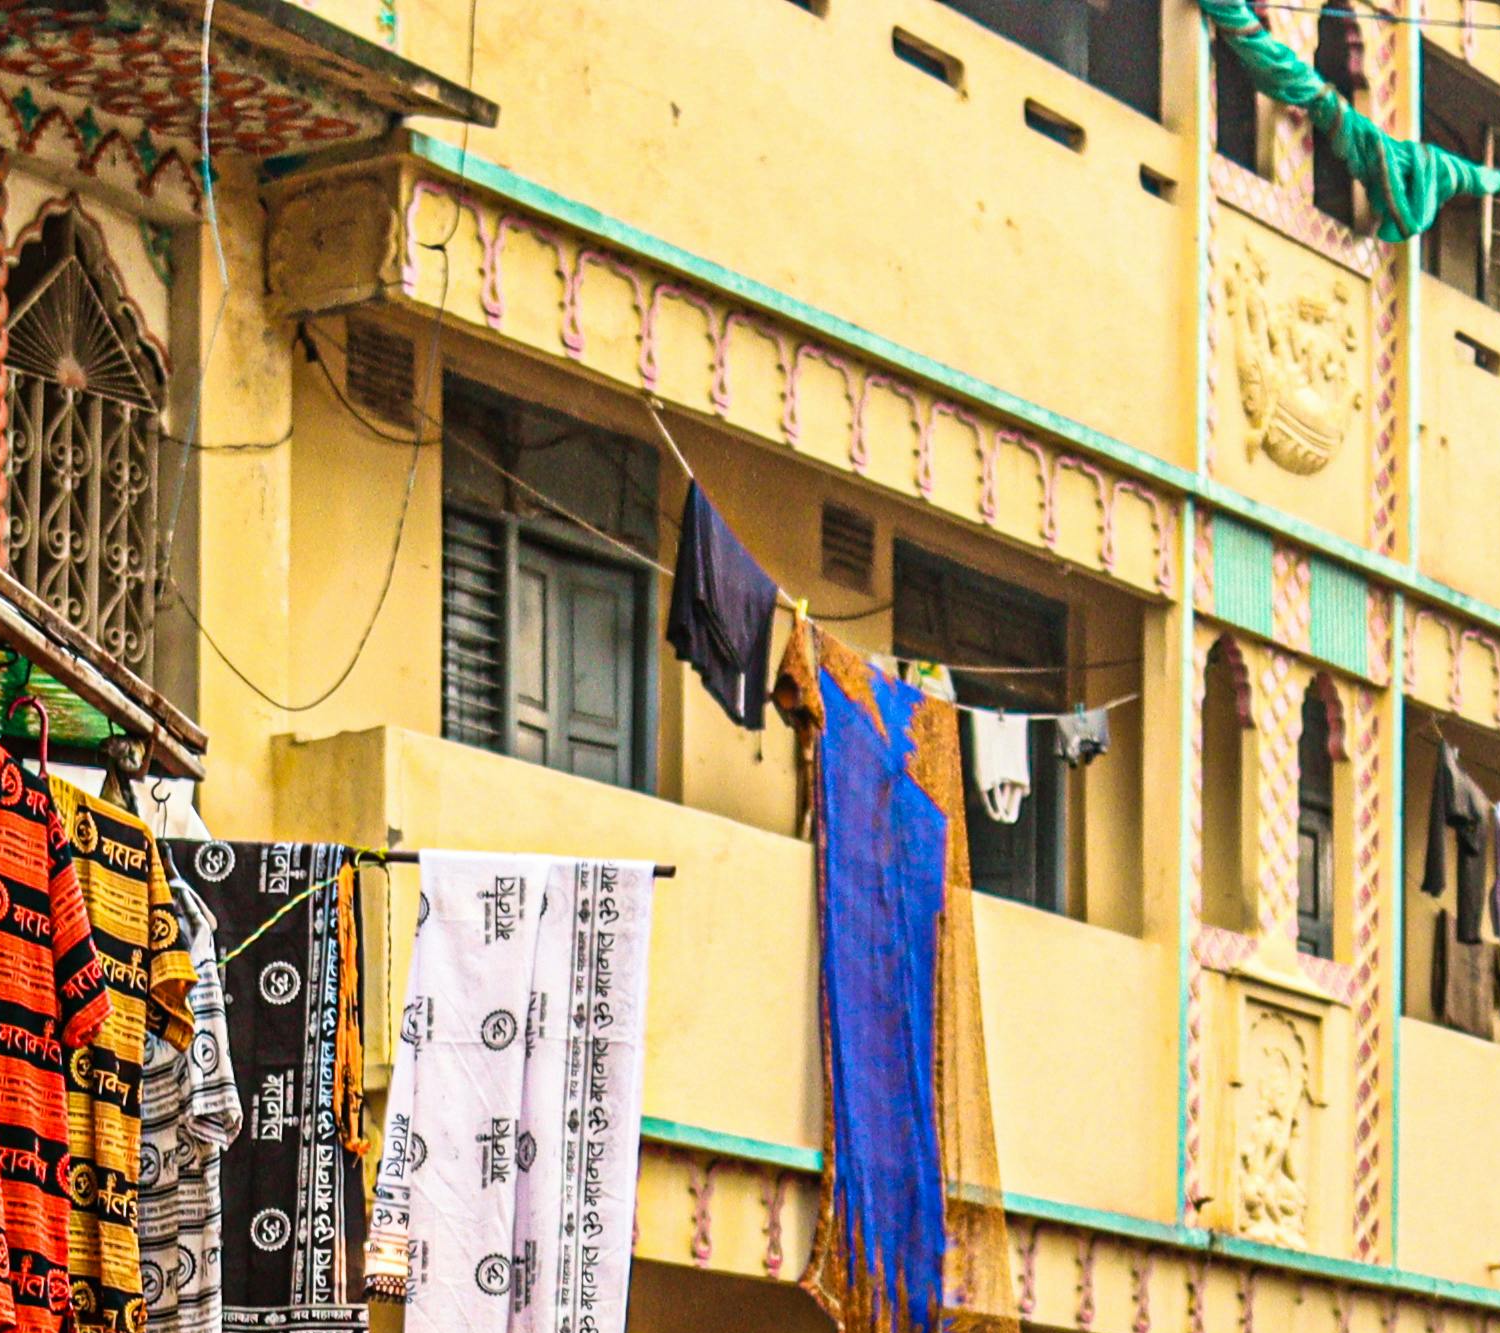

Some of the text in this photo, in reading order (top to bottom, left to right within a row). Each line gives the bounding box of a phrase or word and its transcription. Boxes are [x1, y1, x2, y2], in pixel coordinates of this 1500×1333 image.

[594, 932, 616, 1029] ॐ महाकाल
[588, 1037, 609, 1132] ॐ महाकाल
[316, 1144, 333, 1212] महाकाल
[583, 1141, 604, 1239] ॐ महाकाल
